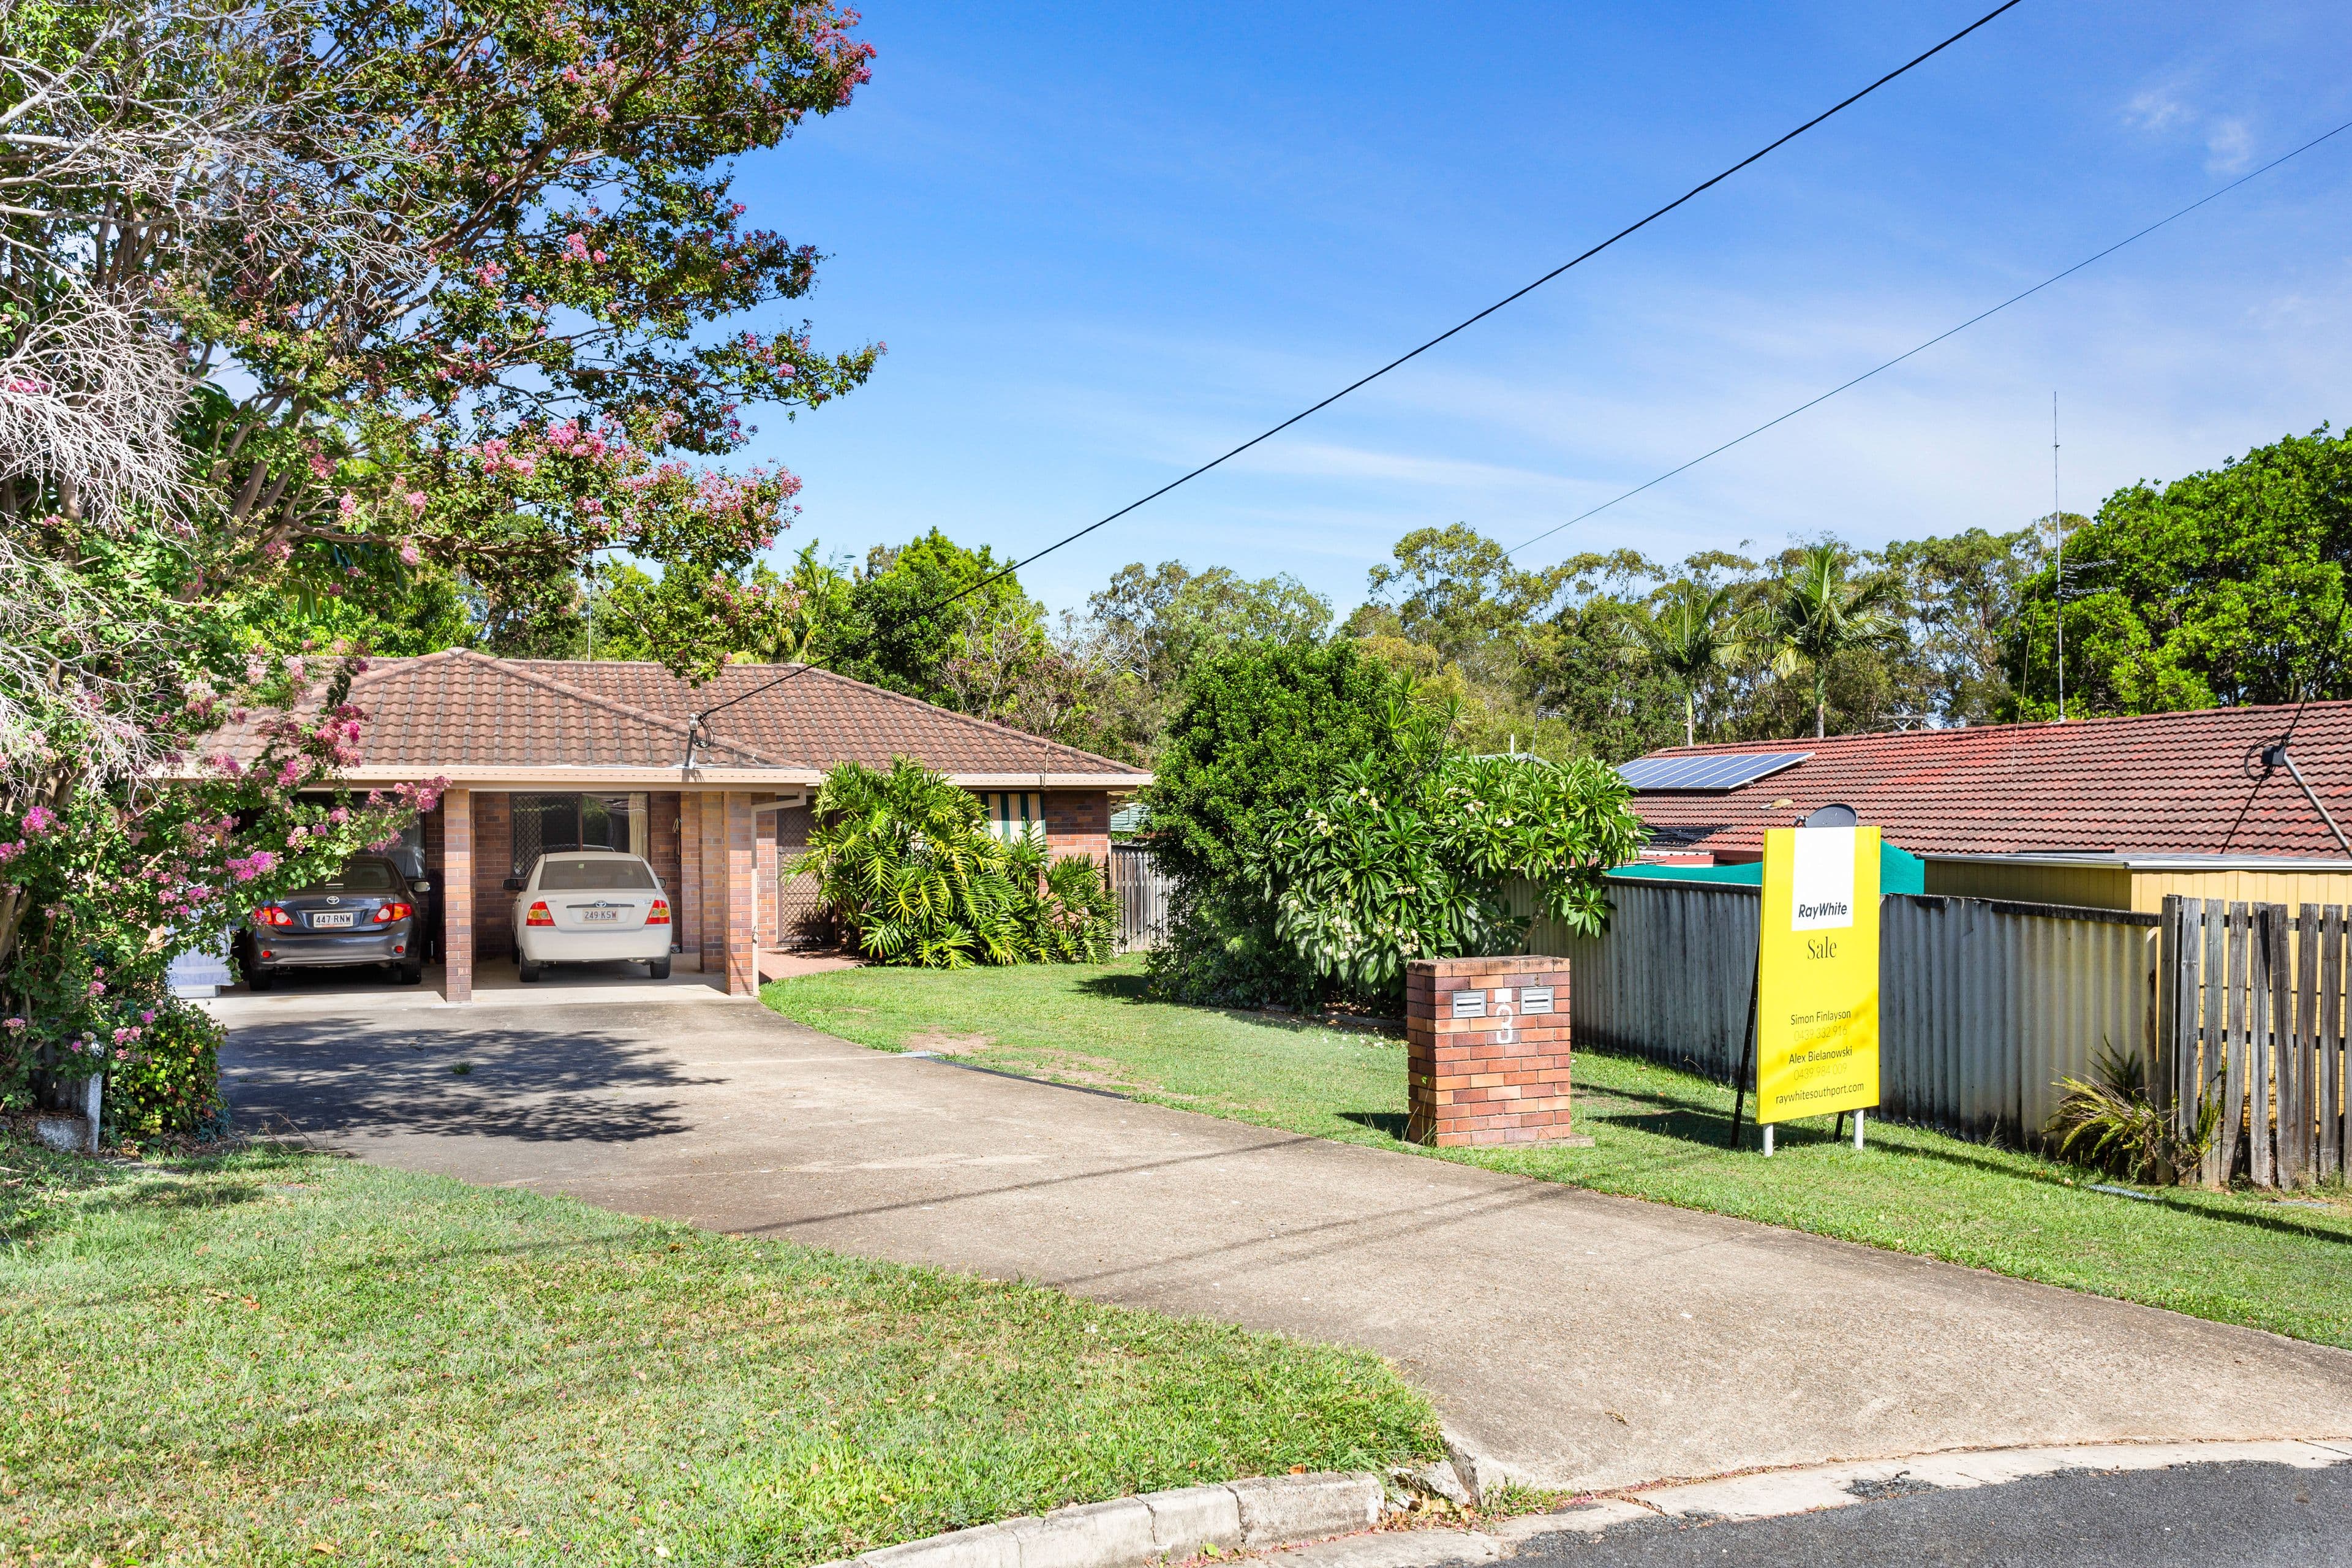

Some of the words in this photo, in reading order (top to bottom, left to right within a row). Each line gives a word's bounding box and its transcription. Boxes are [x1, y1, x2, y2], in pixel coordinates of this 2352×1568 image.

[1798, 902, 1847, 919] RayWhite
[1807, 936, 1837, 960] Sale
[1496, 1004, 1513, 1044] 3
[1790, 1014, 1814, 1025] Simon
[1817, 1011, 1851, 1022] Finlayson
[1817, 1026, 1831, 1039] 332
[1833, 1025, 1847, 1037] 916
[1789, 1053, 1806, 1065] Alex
[1808, 1046, 1852, 1062] Bielanowski
[1776, 1083, 1864, 1105] raywhitesouthport.com
